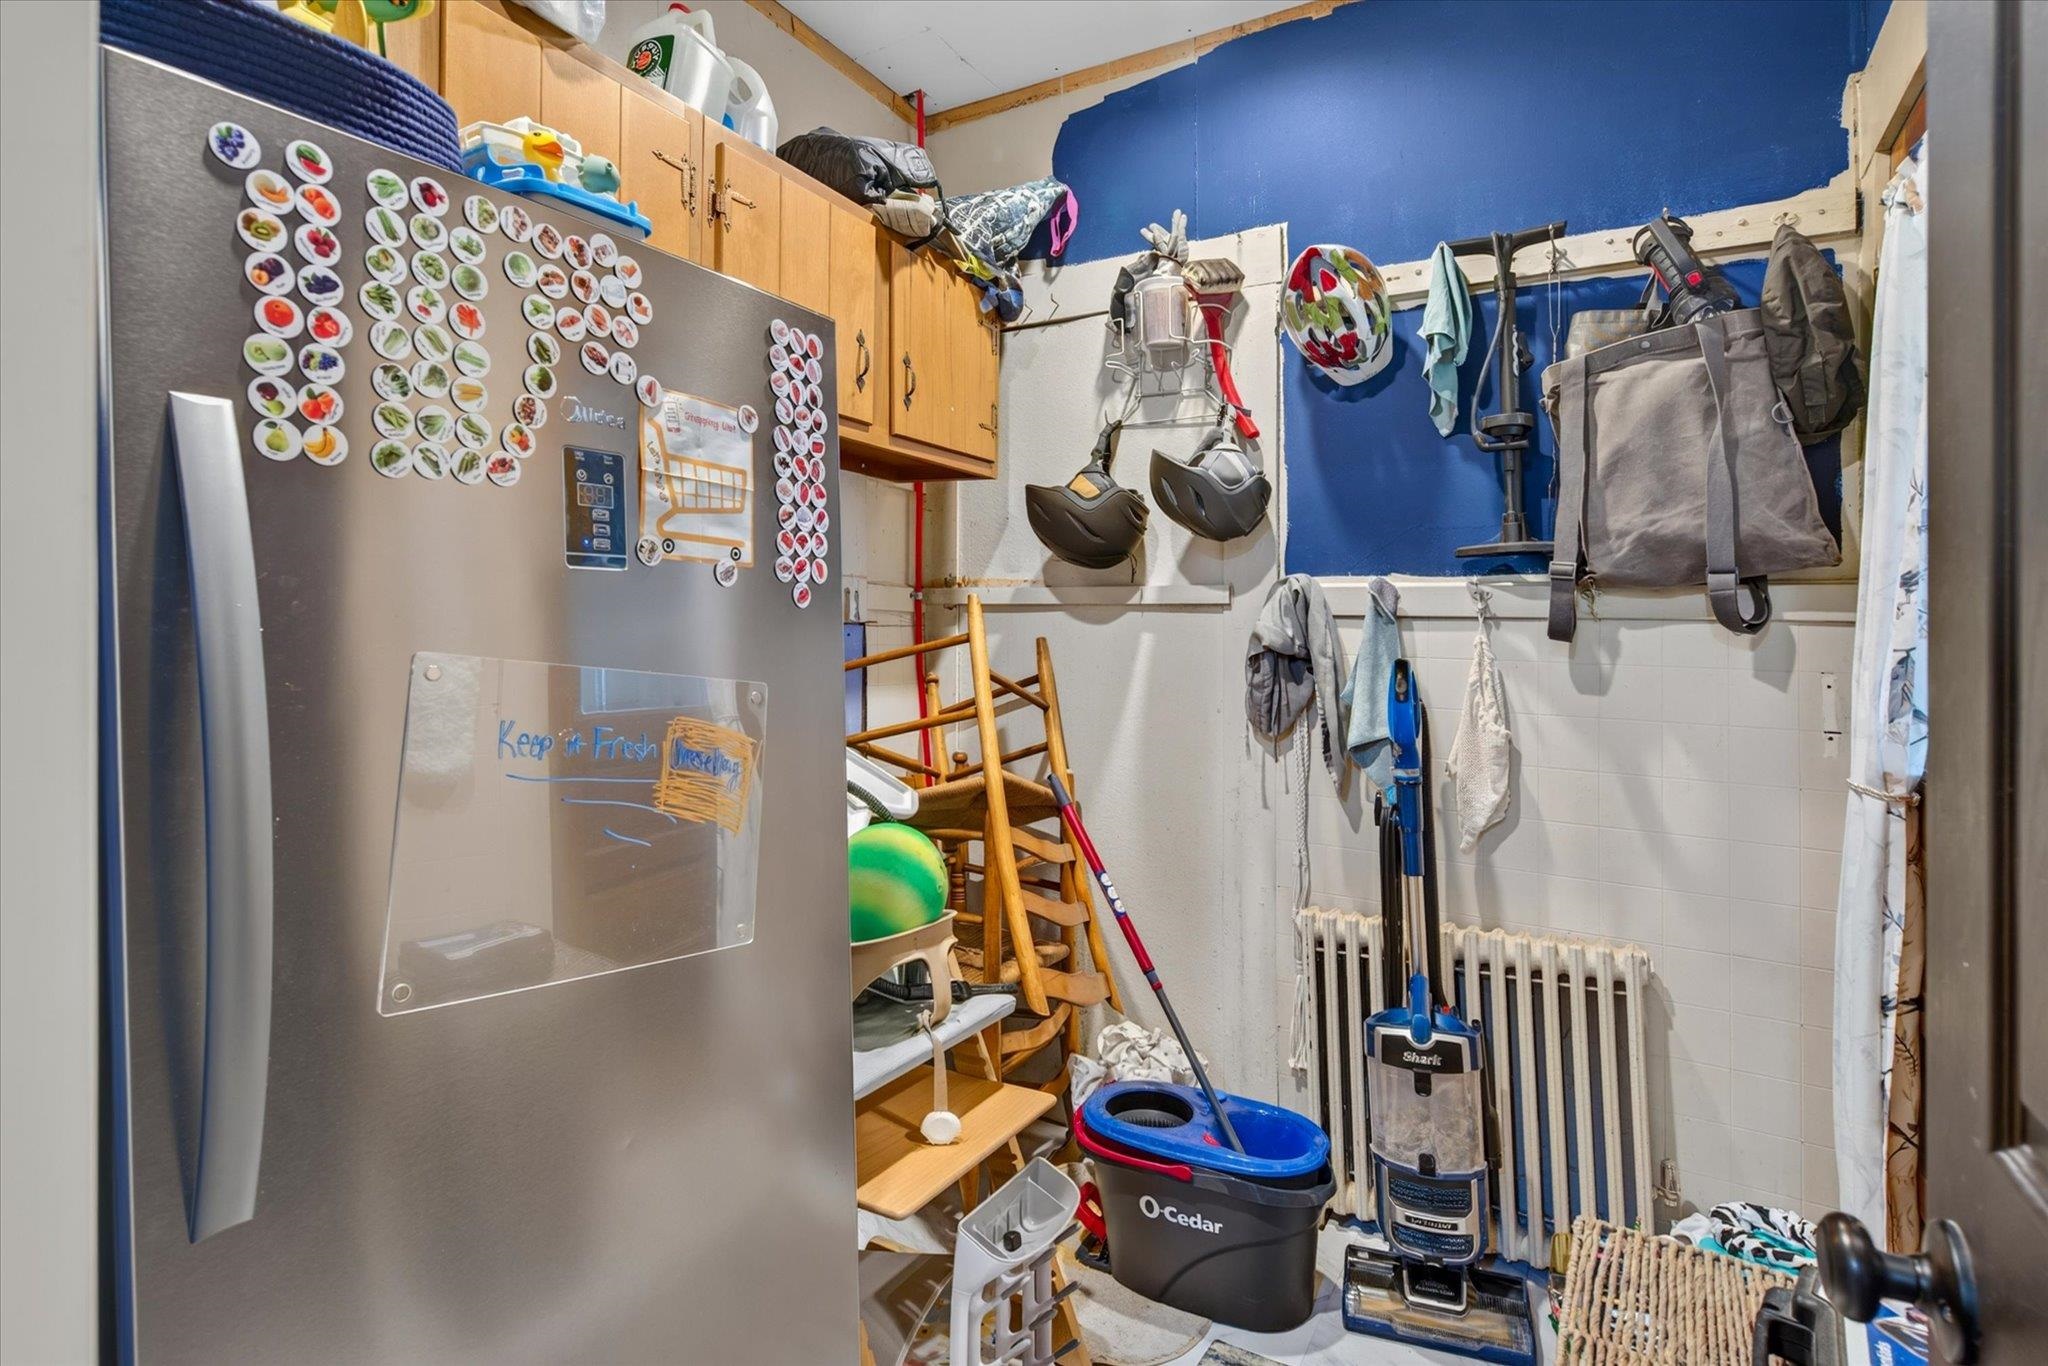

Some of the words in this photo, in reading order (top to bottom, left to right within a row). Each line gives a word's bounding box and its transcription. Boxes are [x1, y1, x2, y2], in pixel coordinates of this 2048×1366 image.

[498, 719, 555, 761] Keep
[594, 726, 658, 761] Fresh
[1402, 1050, 1443, 1066] Shark
[1139, 1194, 1223, 1235] O-Cedar
